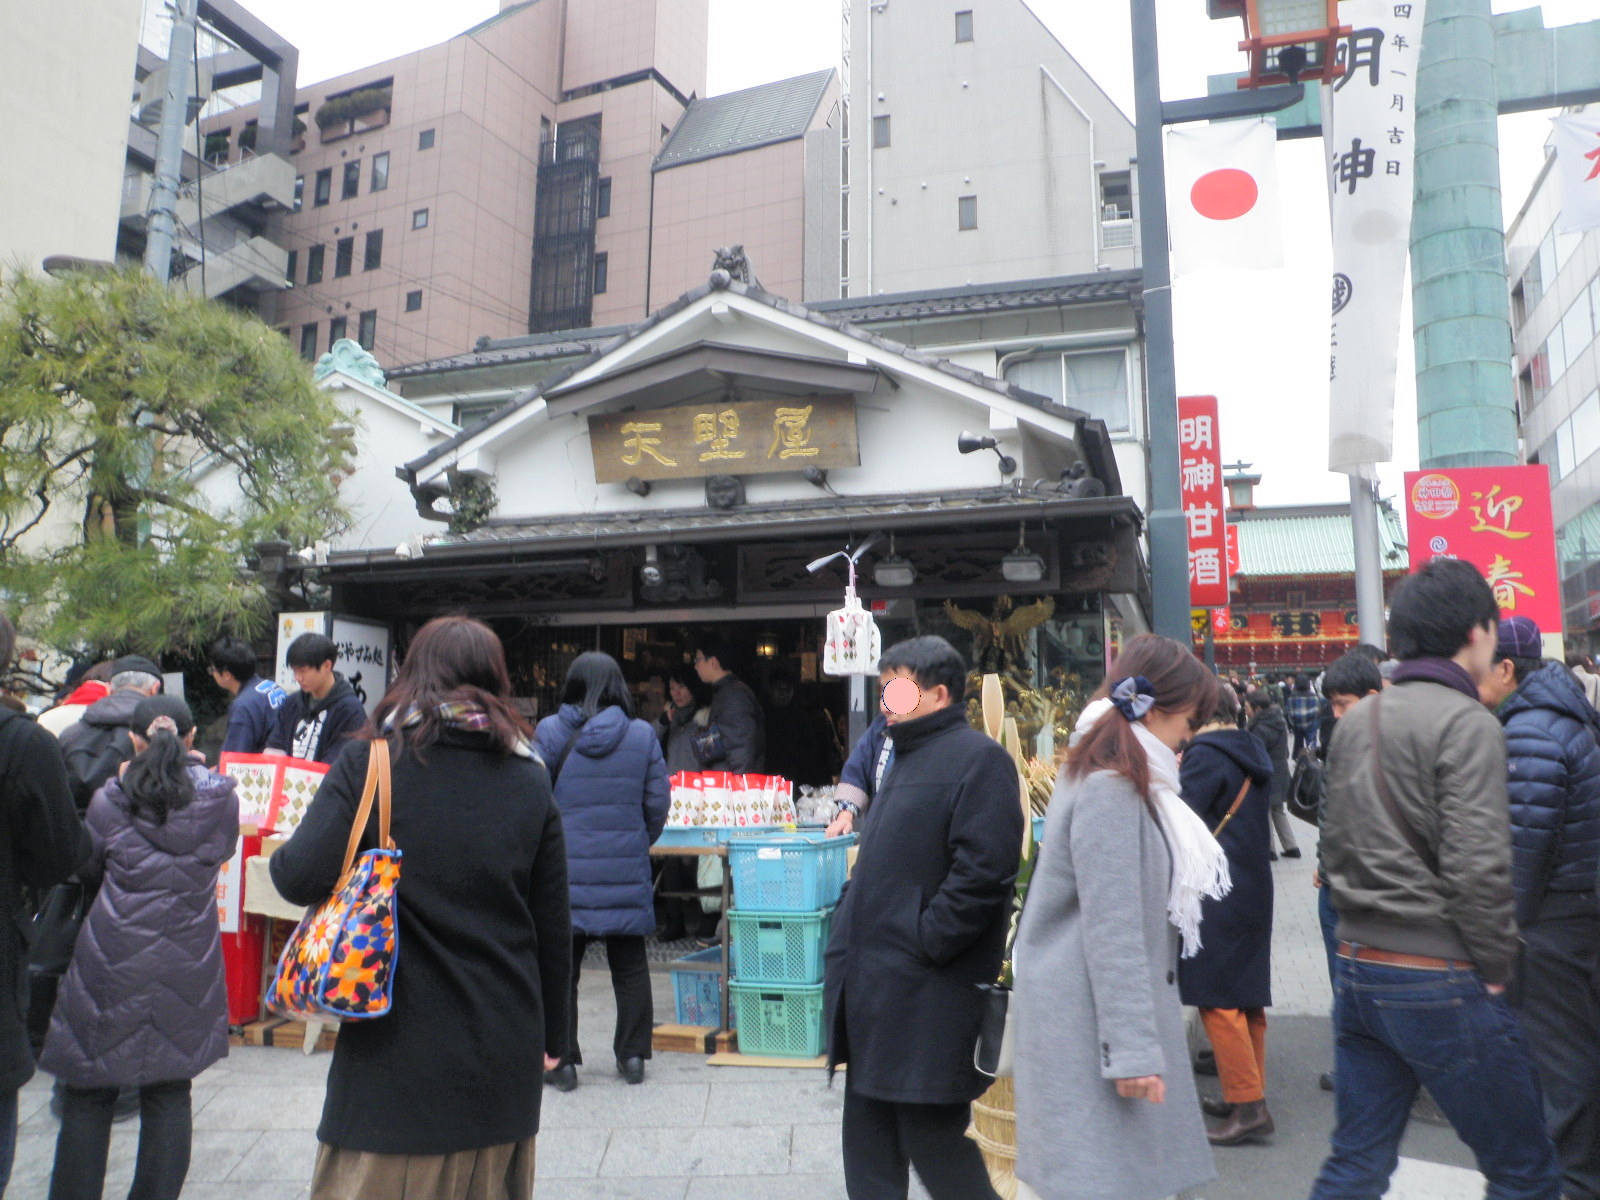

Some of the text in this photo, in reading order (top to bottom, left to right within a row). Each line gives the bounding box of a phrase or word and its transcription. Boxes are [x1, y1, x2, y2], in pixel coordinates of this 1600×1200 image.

[1334, 27, 1385, 195] 明神
[1386, 4, 1412, 176] 四年一月吉日
[1180, 415, 1220, 585] 明神甘酒
[1468, 485, 1536, 610] 迎春
